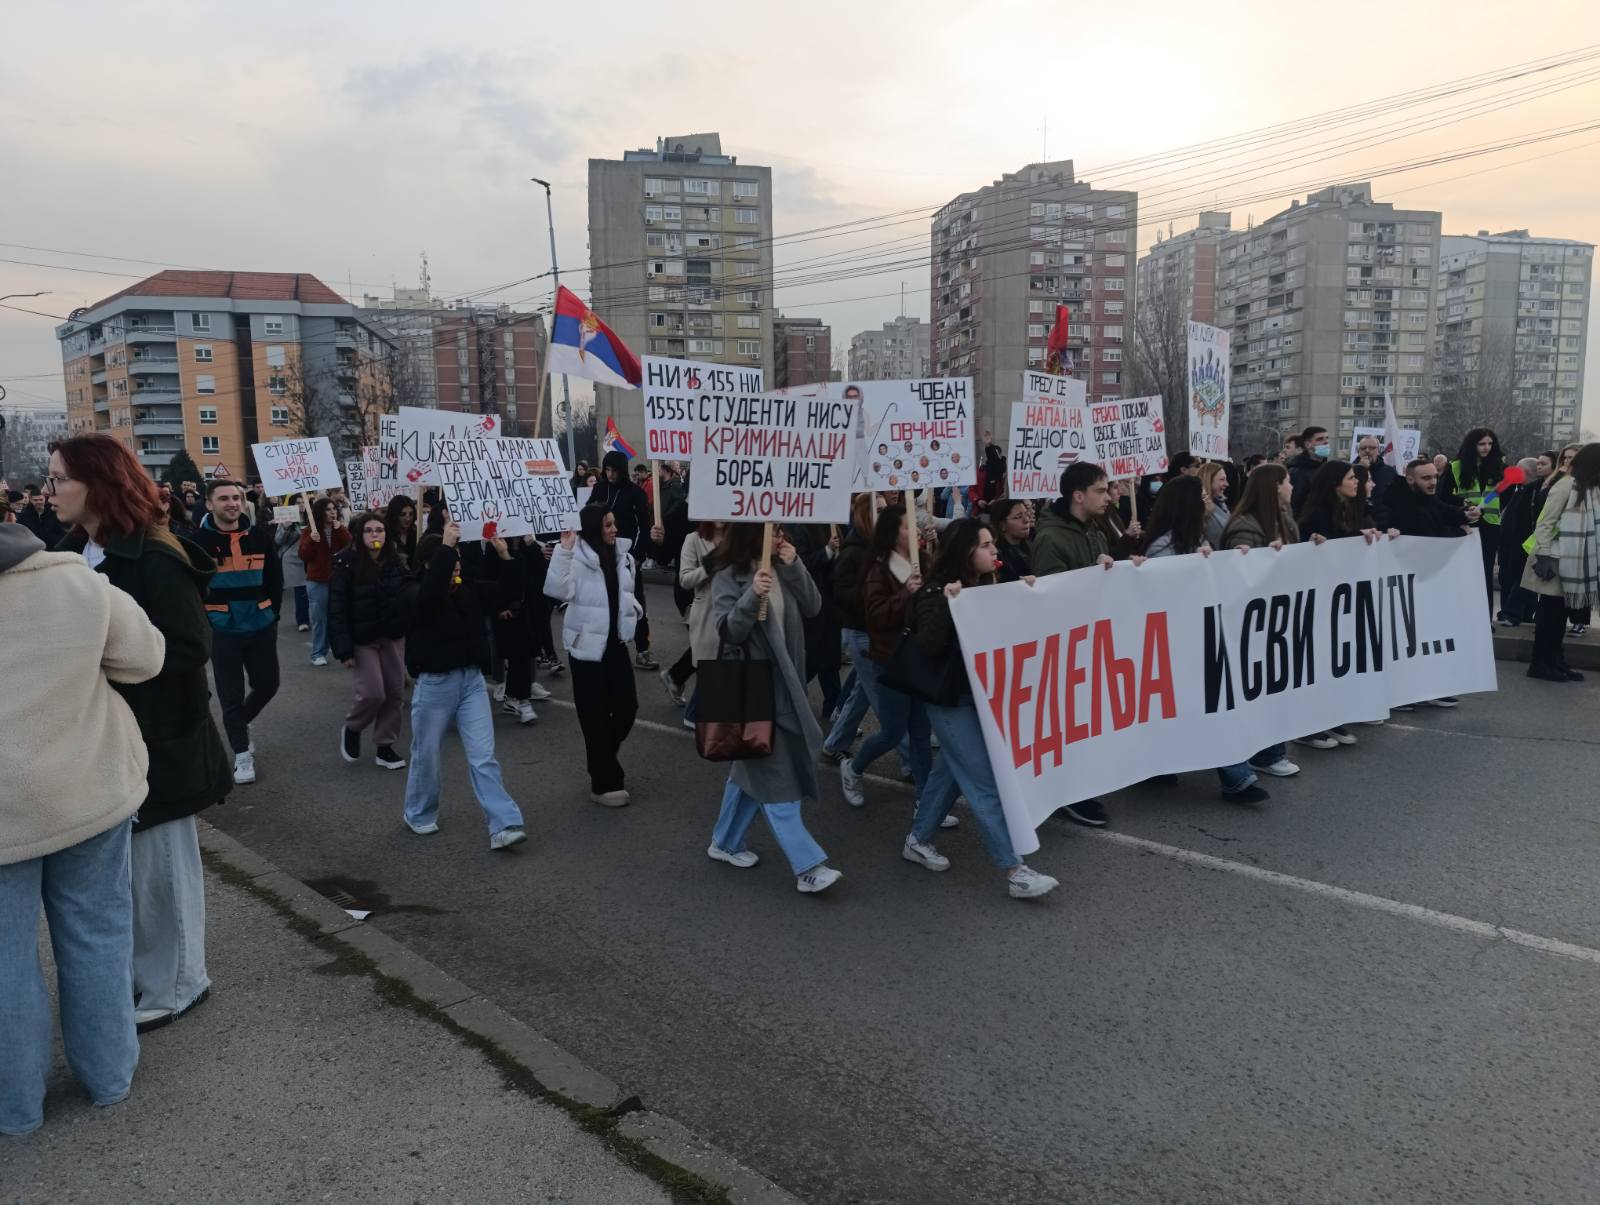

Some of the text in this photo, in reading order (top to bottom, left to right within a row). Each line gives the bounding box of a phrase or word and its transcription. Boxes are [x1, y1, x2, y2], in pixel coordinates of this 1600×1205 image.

[648, 363, 680, 388] НИ
[708, 370, 734, 392] 155
[740, 373, 760, 393] НИ
[1056, 379, 1066, 396] СЕ
[911, 381, 966, 401] ЧОБАН
[699, 395, 796, 427] СТУДЕНТИ
[807, 402, 853, 429] НИСУ
[922, 401, 966, 420] ТЕРА
[1026, 405, 1082, 427] НАПАД НА
[890, 420, 965, 441] ОВЧИЦЕ!
[1016, 427, 1086, 450] ЈЕДНОГ ОД
[434, 438, 555, 462] ХВАЛА МАМА И
[704, 426, 846, 462] КРИМИНАЛЦИ
[1108, 438, 1144, 458] СТУДЕНТЕ
[1146, 435, 1162, 451] САДА
[438, 459, 522, 482] ТАТА ШТО
[1013, 450, 1042, 471] НАС
[716, 459, 832, 489] БОРБА НИЈЕ
[1012, 472, 1058, 493] НАПАД
[444, 480, 492, 502] ЈЕЛИ
[494, 477, 537, 499] НИСТЕ
[538, 477, 567, 496] ЗБОГ
[450, 502, 479, 523] ВАС
[506, 496, 547, 518] ДАНАС
[547, 496, 577, 513] МОЈЕ
[731, 490, 814, 517] ЗЛОЧИН
[524, 513, 566, 534] ЧИСТЕ
[1240, 588, 1316, 701] СВИ
